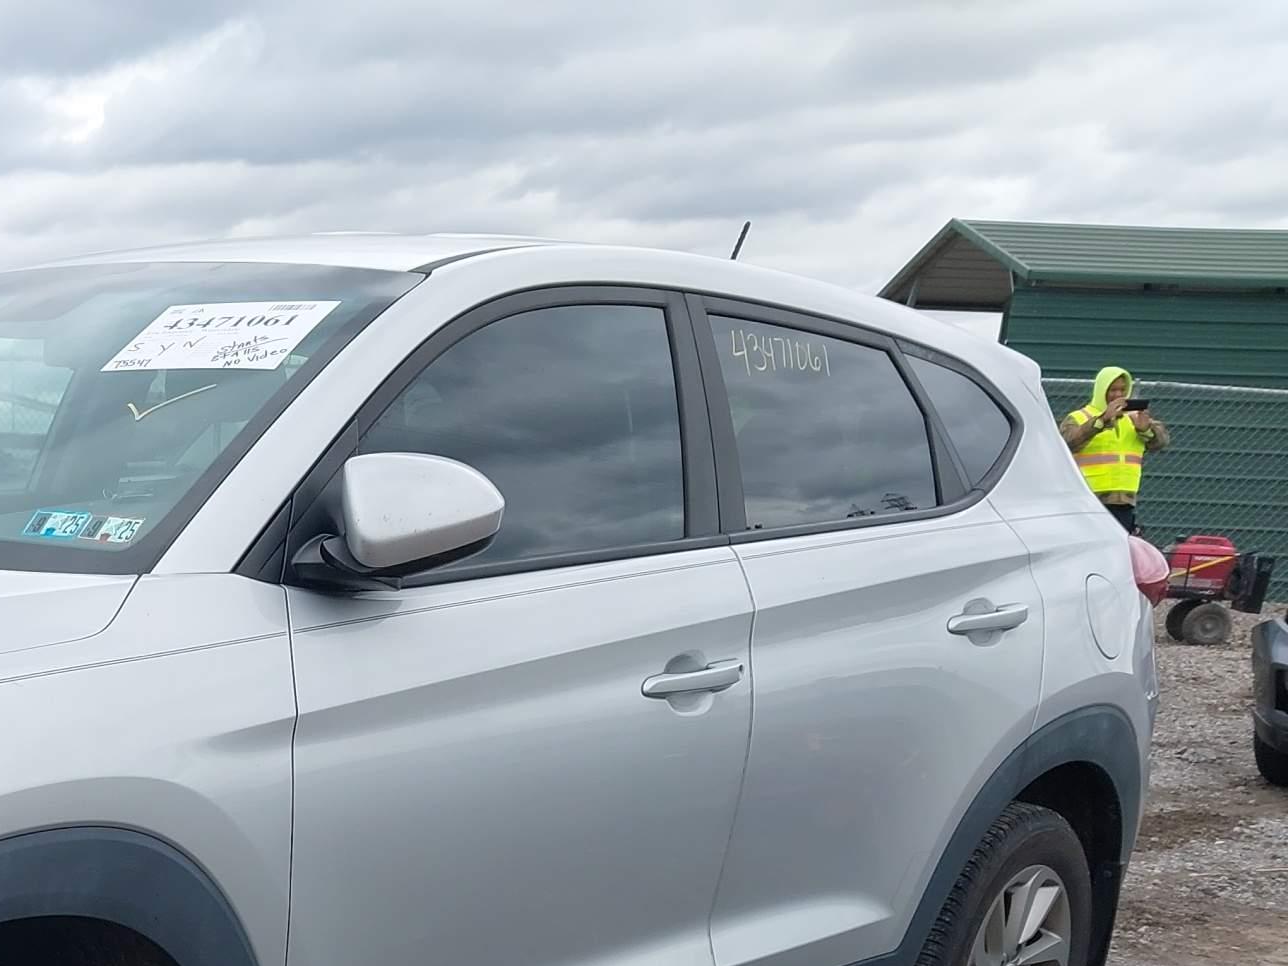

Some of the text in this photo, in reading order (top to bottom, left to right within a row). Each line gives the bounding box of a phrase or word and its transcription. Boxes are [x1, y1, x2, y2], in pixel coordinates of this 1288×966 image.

[163, 314, 300, 331] 43471061
[730, 329, 831, 377] 43471061
[62, 515, 85, 534] 25
[118, 520, 140, 540] 25
